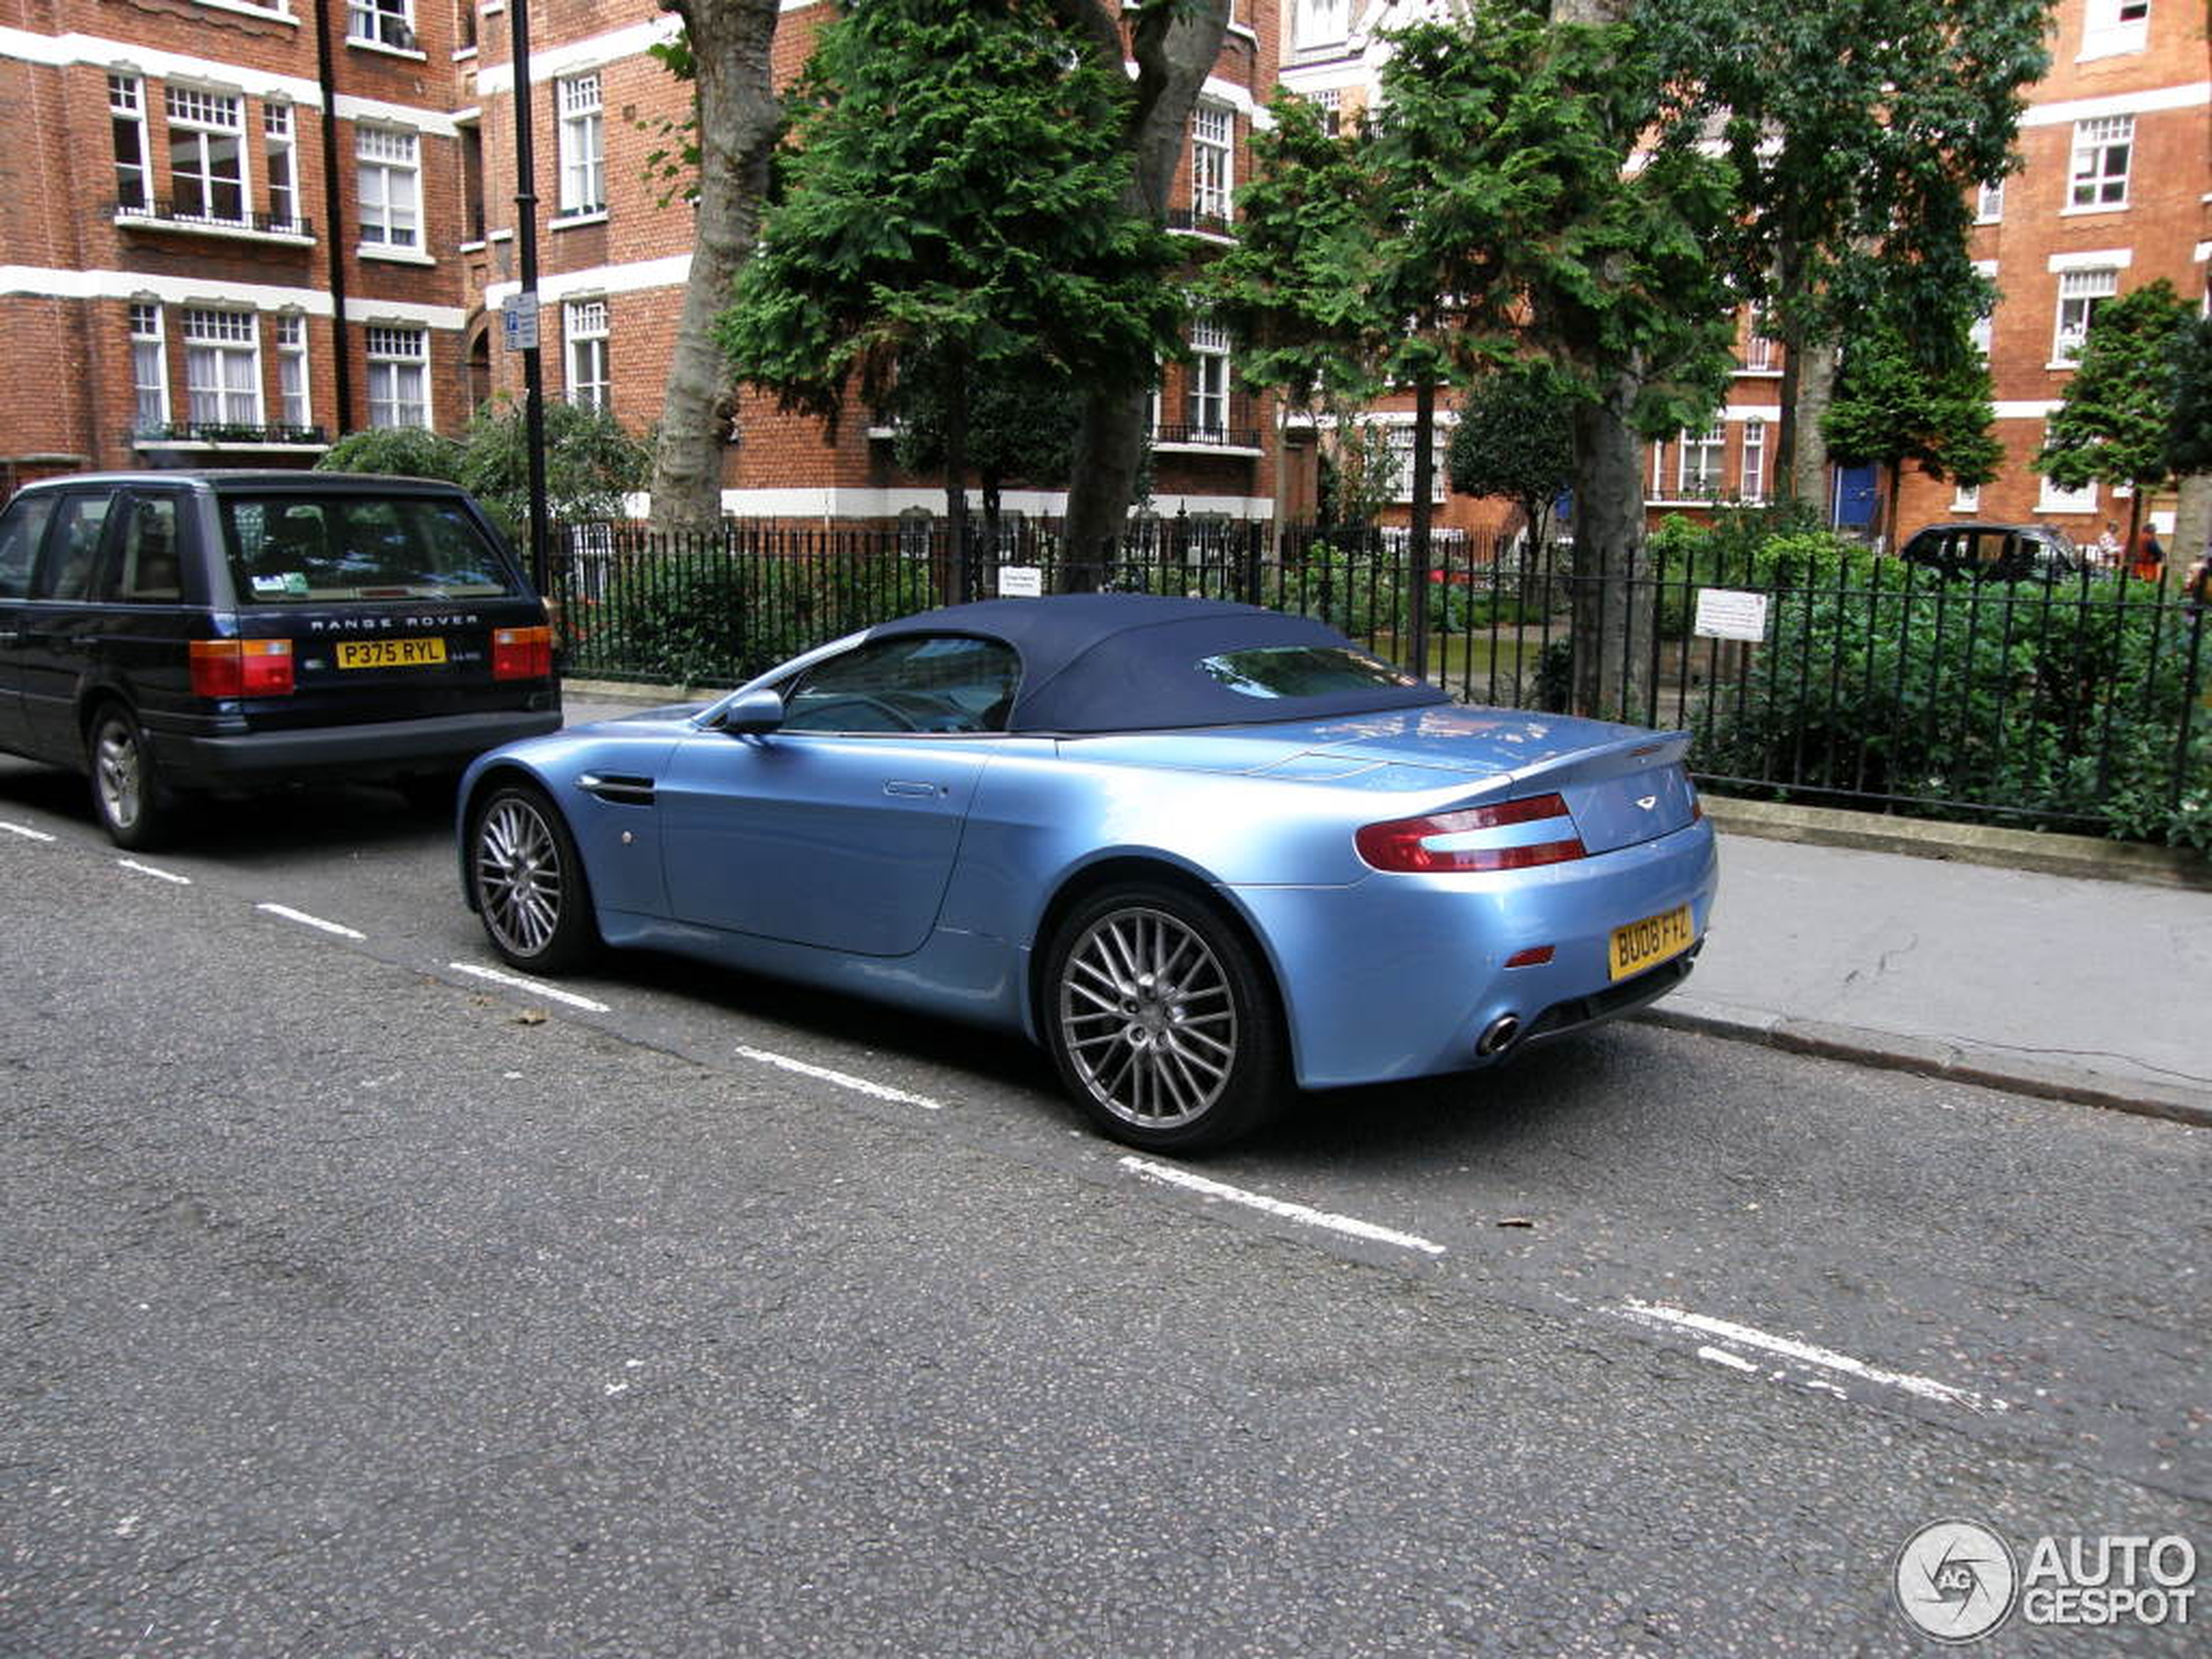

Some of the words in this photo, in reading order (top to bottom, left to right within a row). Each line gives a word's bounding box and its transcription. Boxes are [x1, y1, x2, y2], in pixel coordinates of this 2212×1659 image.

[311, 619, 392, 631] RANGE
[406, 615, 478, 626] ROVER
[345, 644, 395, 664] P375
[404, 641, 441, 661] RYL
